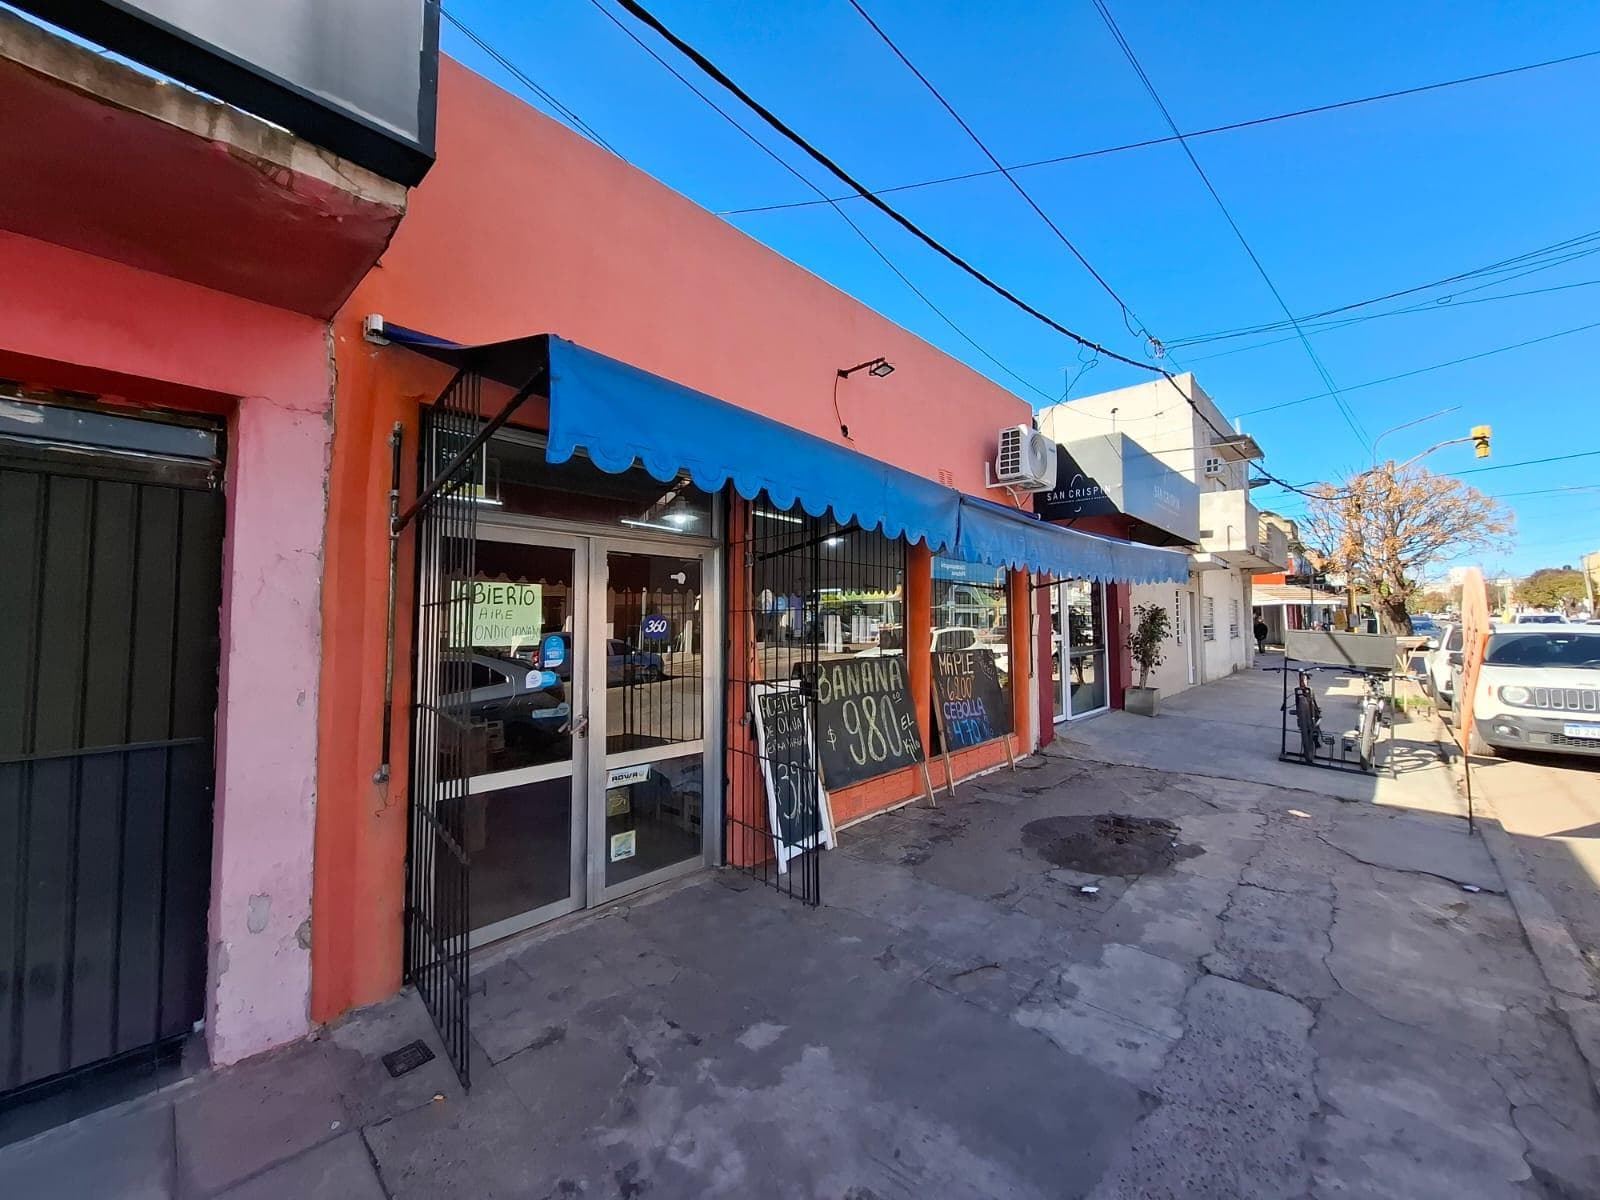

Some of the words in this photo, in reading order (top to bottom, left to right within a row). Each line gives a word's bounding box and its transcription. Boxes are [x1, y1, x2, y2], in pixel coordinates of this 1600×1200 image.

[1046, 491, 1065, 501] SAN
[1068, 484, 1111, 498] CRISPIN
[645, 620, 667, 633] 360
[938, 653, 974, 676] MAPLE
[817, 659, 904, 704] BANANA
[943, 697, 986, 719] CEBOLLA
[842, 694, 902, 766] 980
